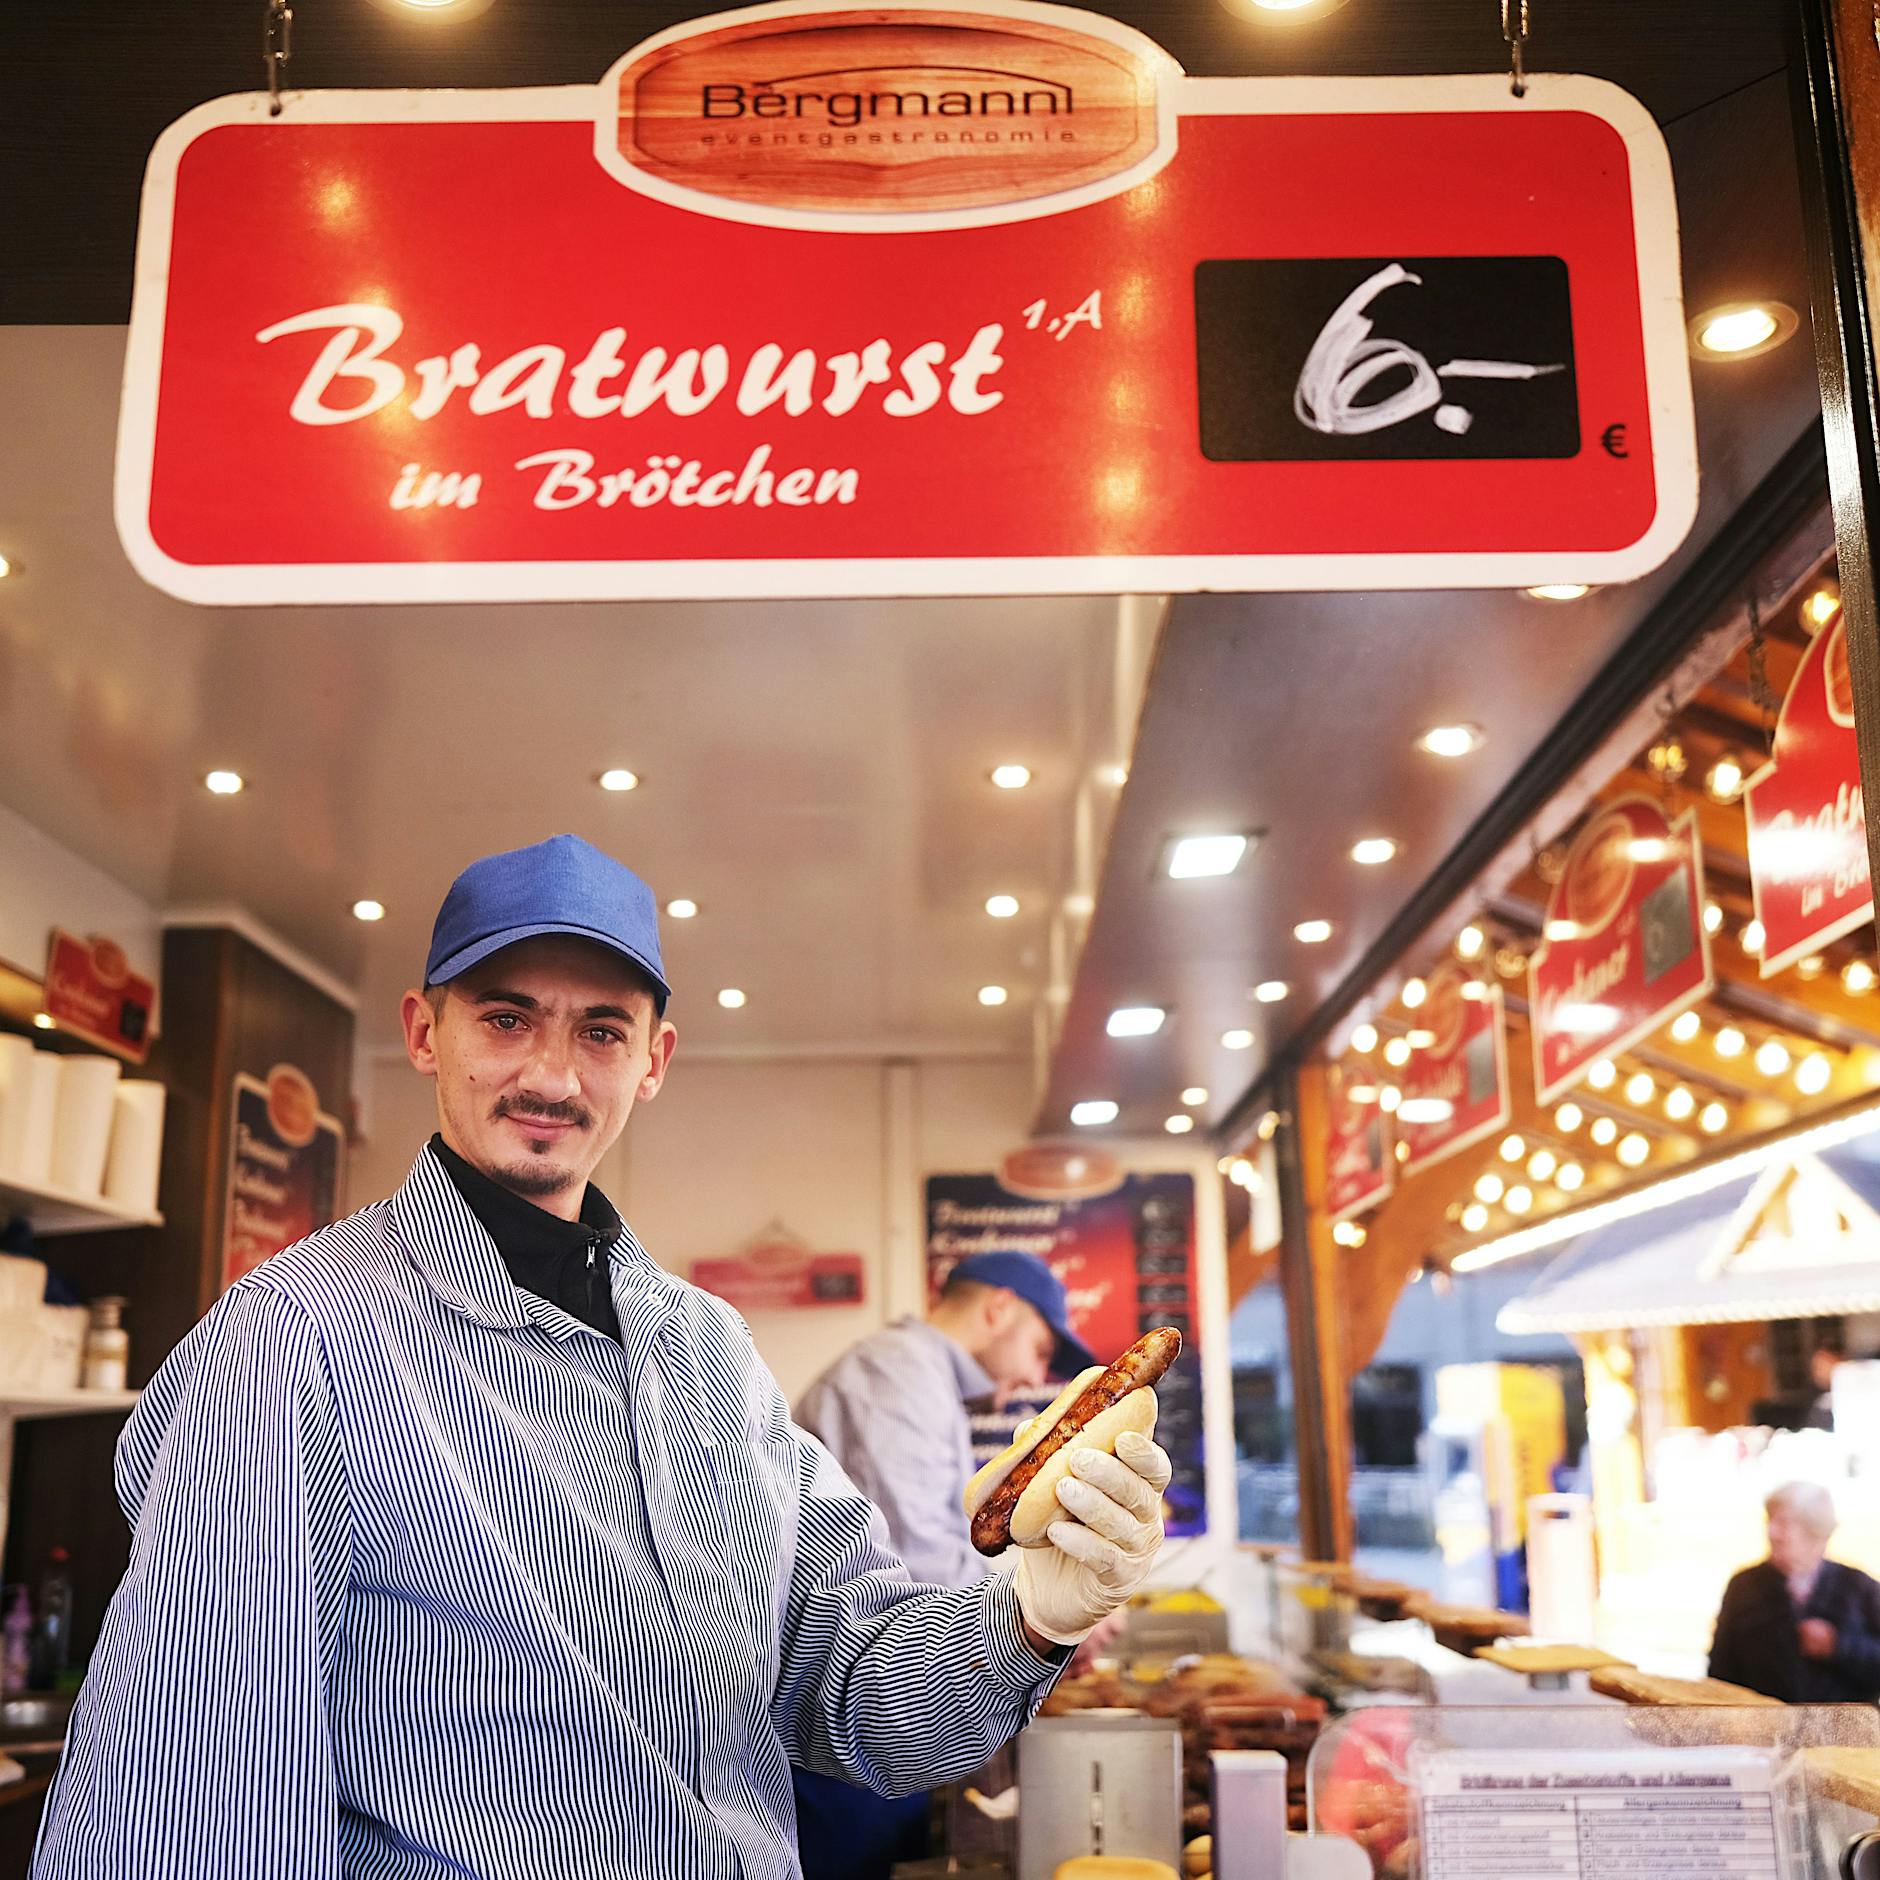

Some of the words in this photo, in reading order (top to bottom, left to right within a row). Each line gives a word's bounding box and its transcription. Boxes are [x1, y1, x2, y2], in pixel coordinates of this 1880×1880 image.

[703, 84, 1058, 127] Bergmann
[700, 130, 1076, 147] eventgastronomie
[256, 303, 1004, 426] Bratwurst
[1601, 423, 1629, 459] €
[389, 463, 481, 510] im
[516, 444, 859, 510] Brötchen
